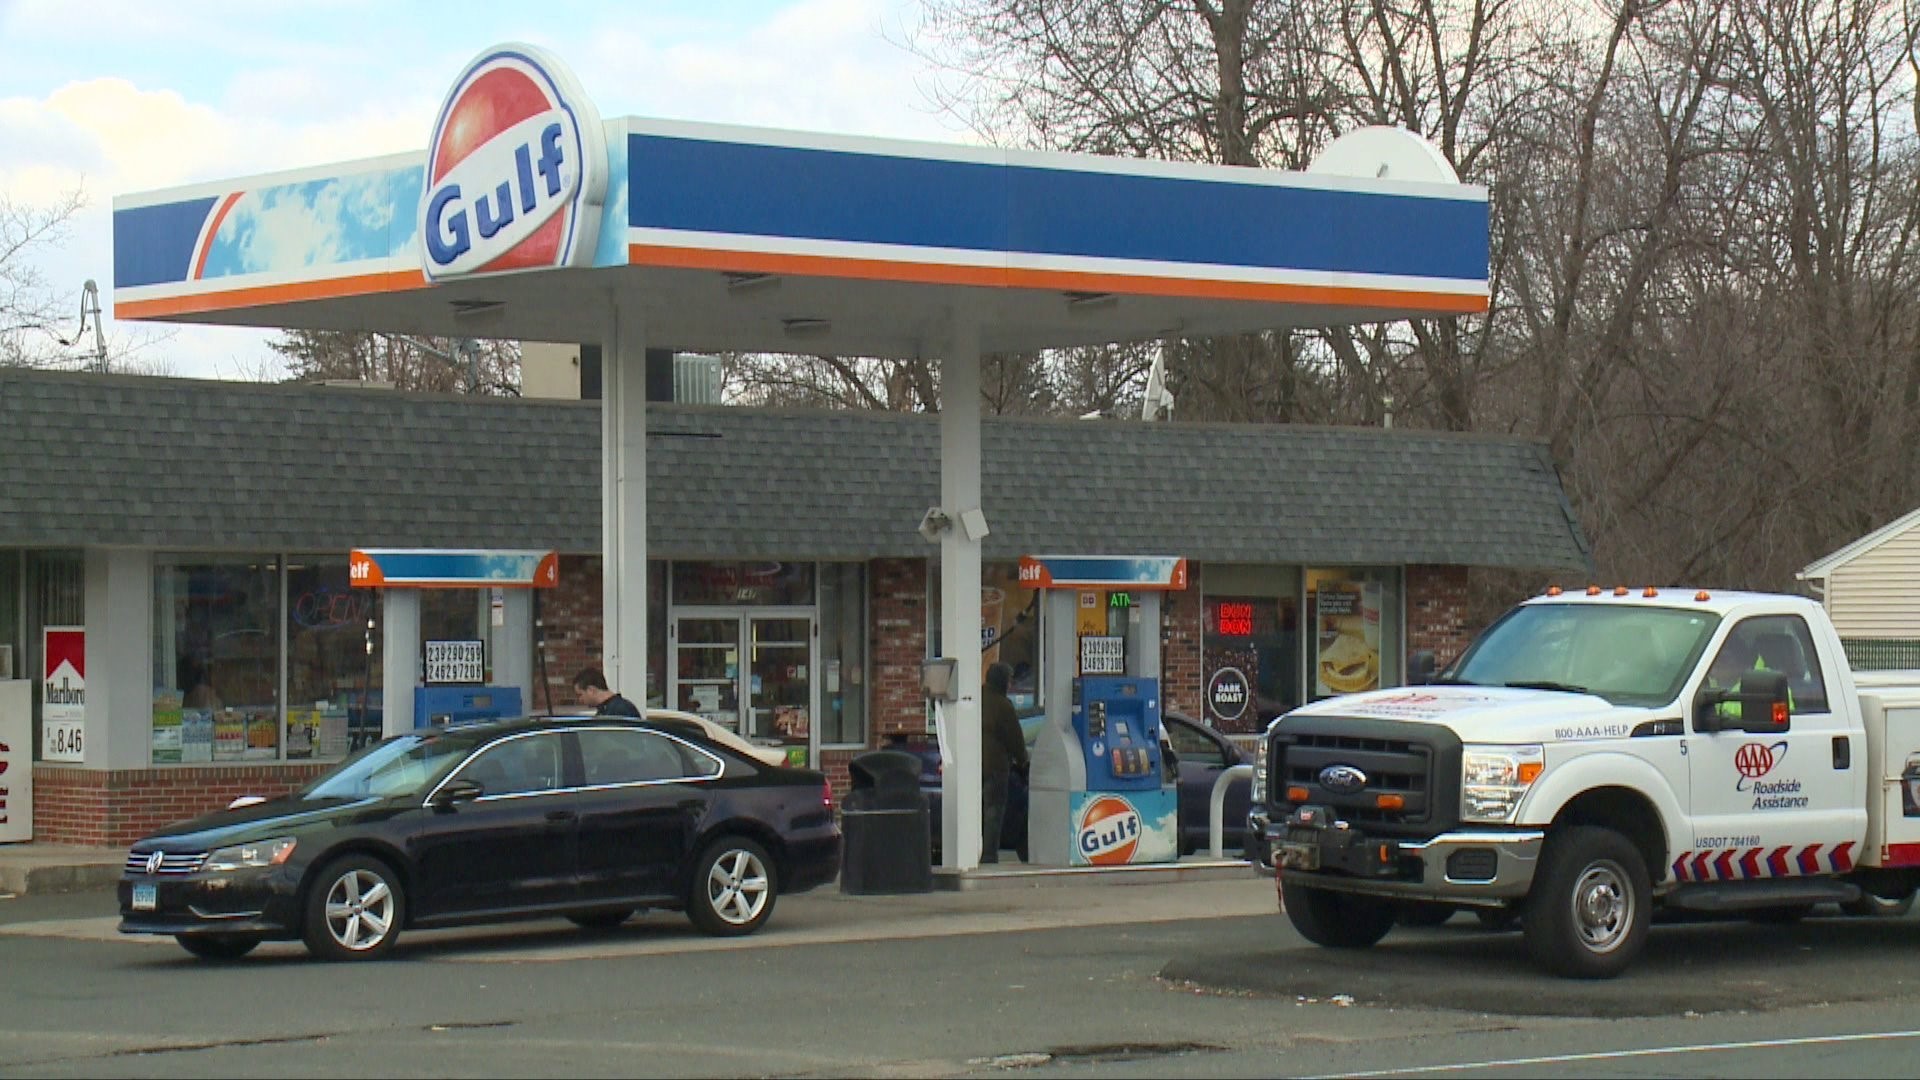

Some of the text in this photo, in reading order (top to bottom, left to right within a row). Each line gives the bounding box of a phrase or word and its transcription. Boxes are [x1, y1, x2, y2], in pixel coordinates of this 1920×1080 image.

[426, 123, 564, 262] Gulf
[350, 561, 370, 579] elf
[546, 565, 554, 581] 4
[46, 677, 85, 705] Marlboro
[1217, 683, 1241, 693] DARK
[1215, 693, 1244, 703] ROAST
[58, 728, 82, 754] 8.46
[1680, 739, 1688, 756] 5
[1739, 744, 1770, 777] AAA
[1753, 779, 1802, 795] Roadside
[1752, 796, 1809, 811] Assistance
[1081, 816, 1137, 853] Gulf
[1696, 836, 1728, 849] USDOT
